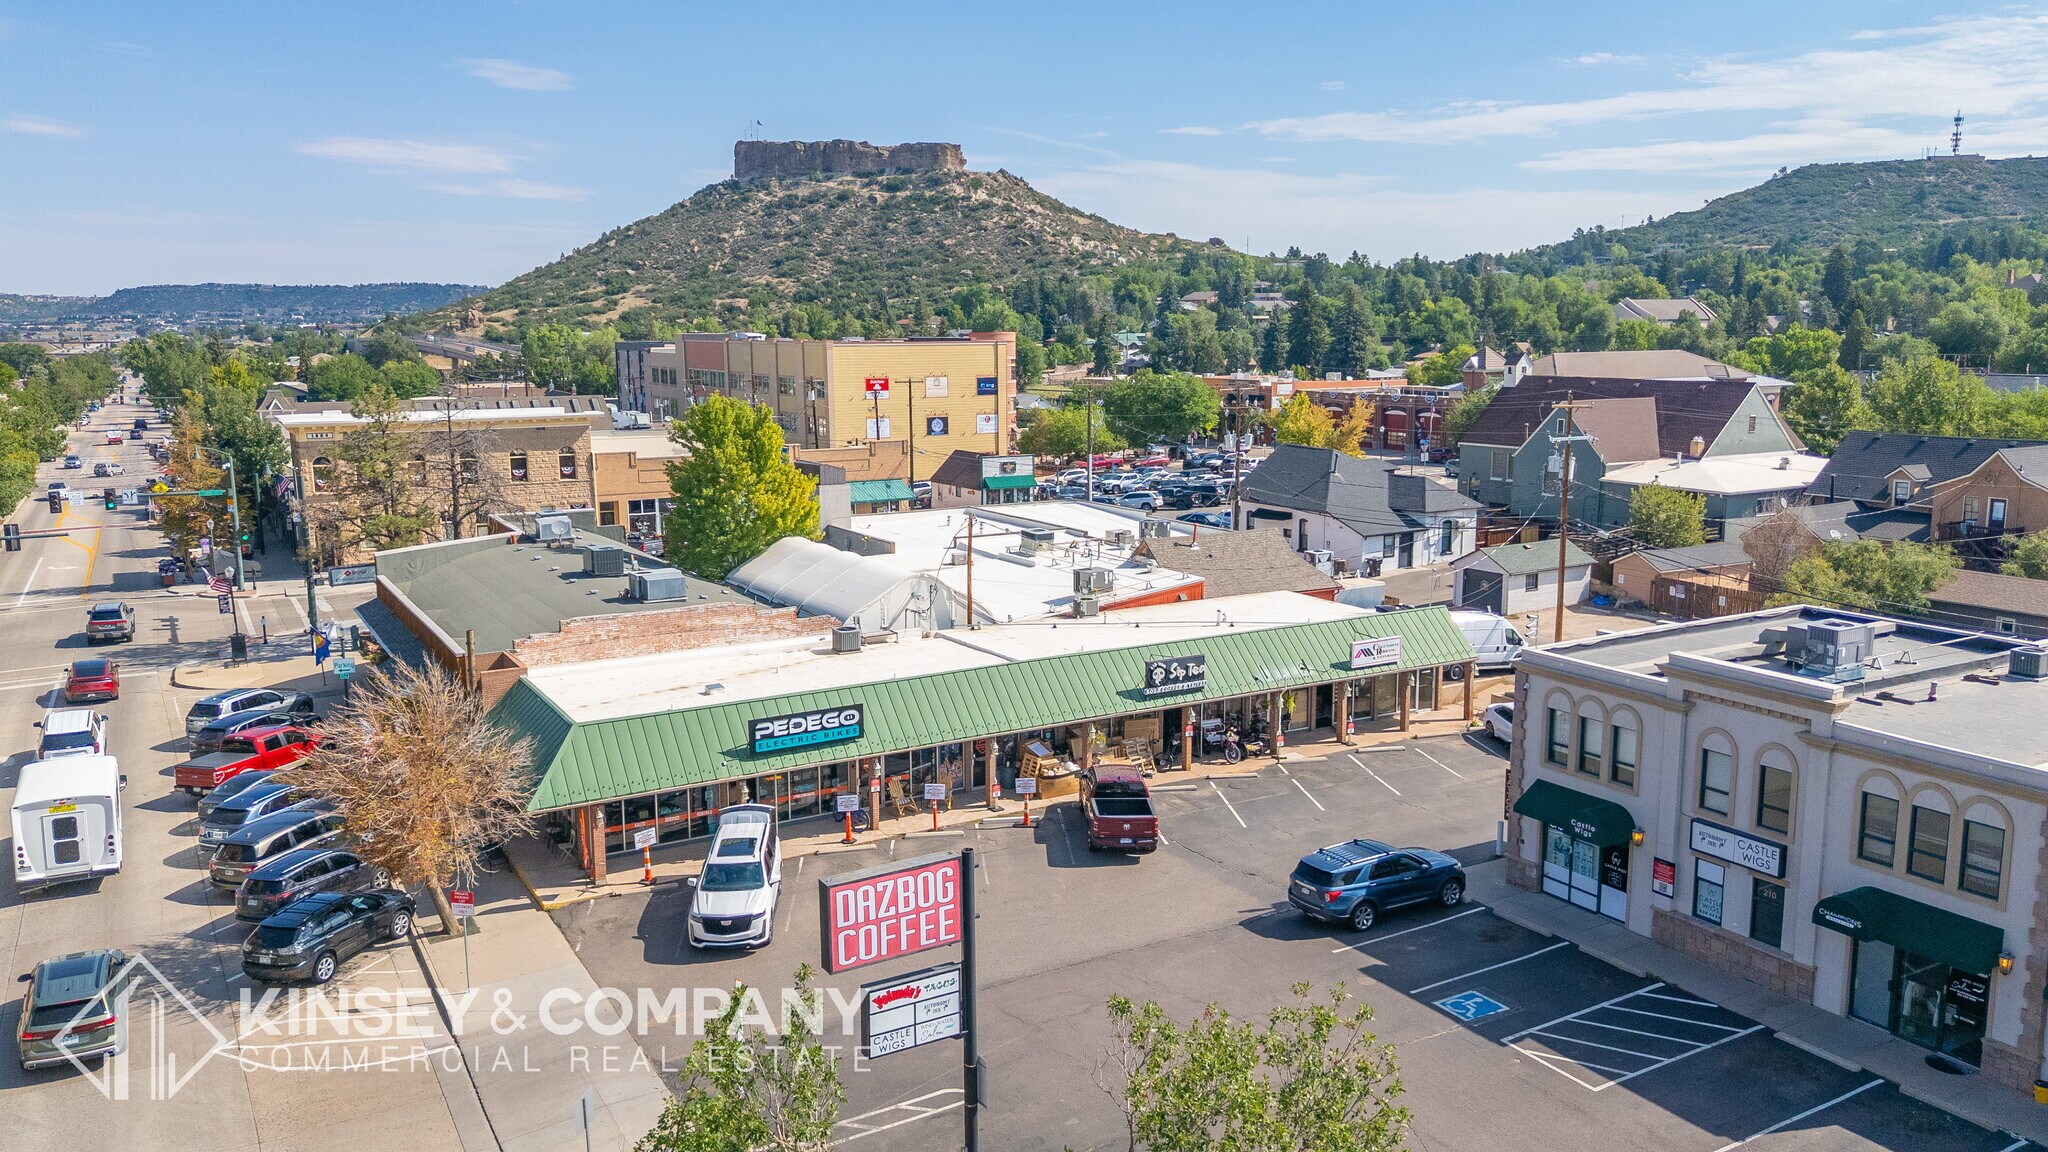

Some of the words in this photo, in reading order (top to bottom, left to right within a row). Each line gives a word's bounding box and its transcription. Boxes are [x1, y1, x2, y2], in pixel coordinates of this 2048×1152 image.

[334, 662, 355, 670] Parking
[1169, 662, 1187, 681] Sip
[755, 709, 860, 740] PEDEGO
[758, 731, 818, 750] ELECTRIC
[824, 727, 858, 739] BIKES
[1571, 818, 1596, 833] Castle
[1574, 826, 1592, 838] Wigs
[1707, 839, 1717, 848] INK
[1737, 839, 1778, 861] CASTLE
[1742, 851, 1771, 870] WIGS
[835, 866, 954, 929] DAZBOG
[1763, 888, 1777, 900] 210
[1818, 907, 1862, 929] CHAMPIONS
[837, 903, 956, 966] COFFEE
[872, 985, 922, 1010] Yolanda's
[923, 998, 952, 1011] AUTONOMY
[873, 1027, 911, 1046] CASTLE
[920, 1024, 944, 1041] Salon
[878, 1039, 906, 1054] WIGS
